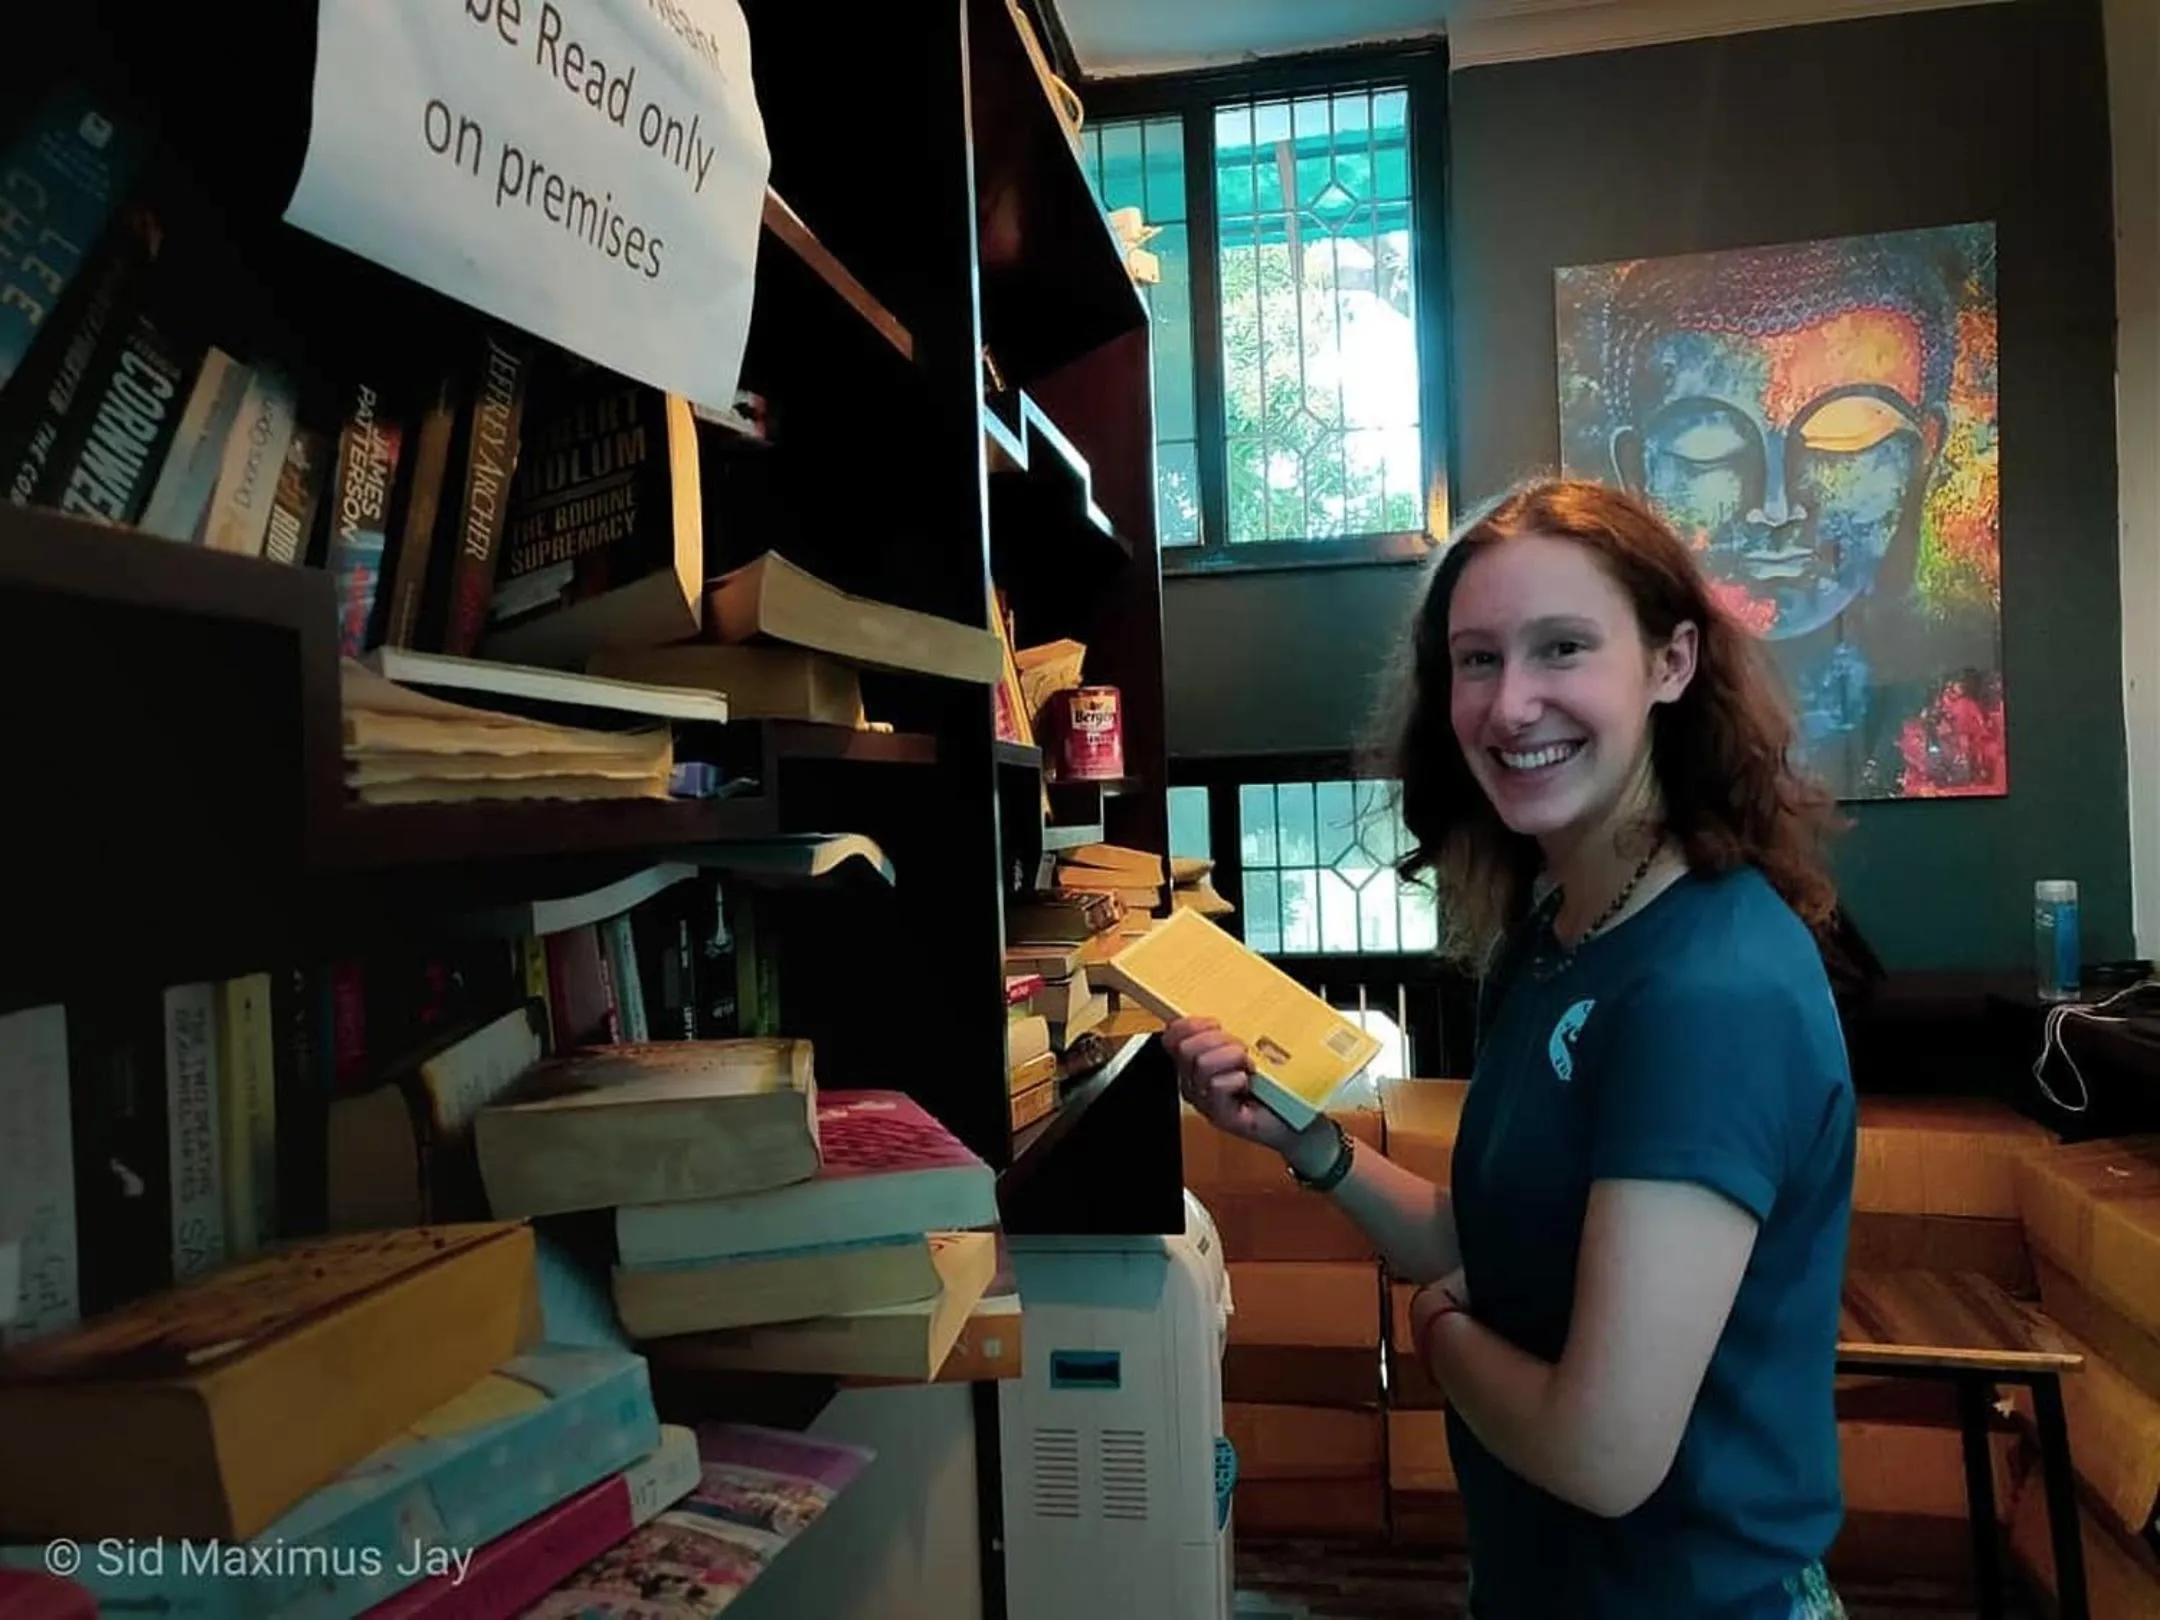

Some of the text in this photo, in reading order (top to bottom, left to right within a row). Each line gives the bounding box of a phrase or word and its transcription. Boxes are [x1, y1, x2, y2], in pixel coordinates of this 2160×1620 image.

[536, 2, 635, 127] Read
[639, 102, 715, 193] only
[424, 99, 664, 278] on premises
[3, 224, 82, 327] LEE
[480, 334, 524, 456] JEFFREY
[339, 382, 378, 543] PATTERSON
[361, 425, 391, 521] JAMES
[463, 446, 508, 563] ARCHER
[511, 482, 638, 546] THE BOURNE
[510, 508, 639, 578] SUPREMACY
